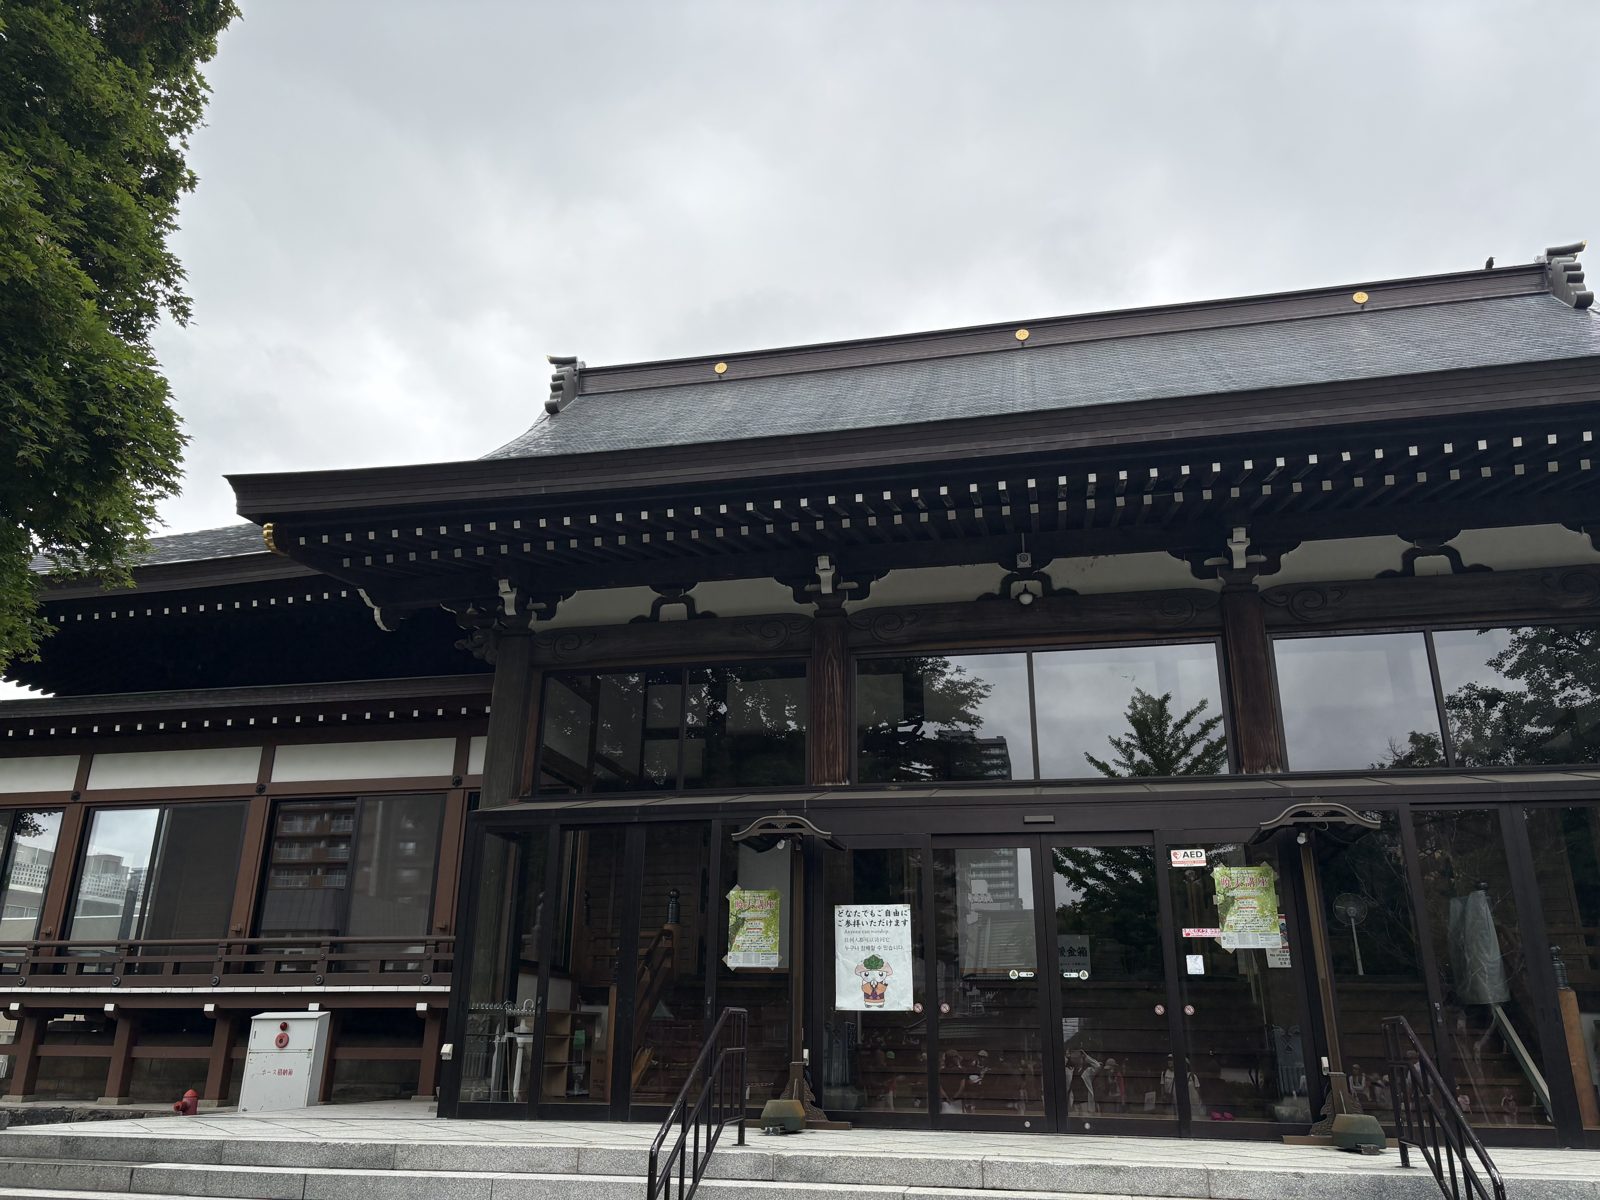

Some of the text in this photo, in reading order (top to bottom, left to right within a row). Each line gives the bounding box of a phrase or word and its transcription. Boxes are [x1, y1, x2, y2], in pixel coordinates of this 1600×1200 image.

[837, 908, 909, 918] どなたでもご自由に
[837, 918, 909, 928] ご参拝いただけます
